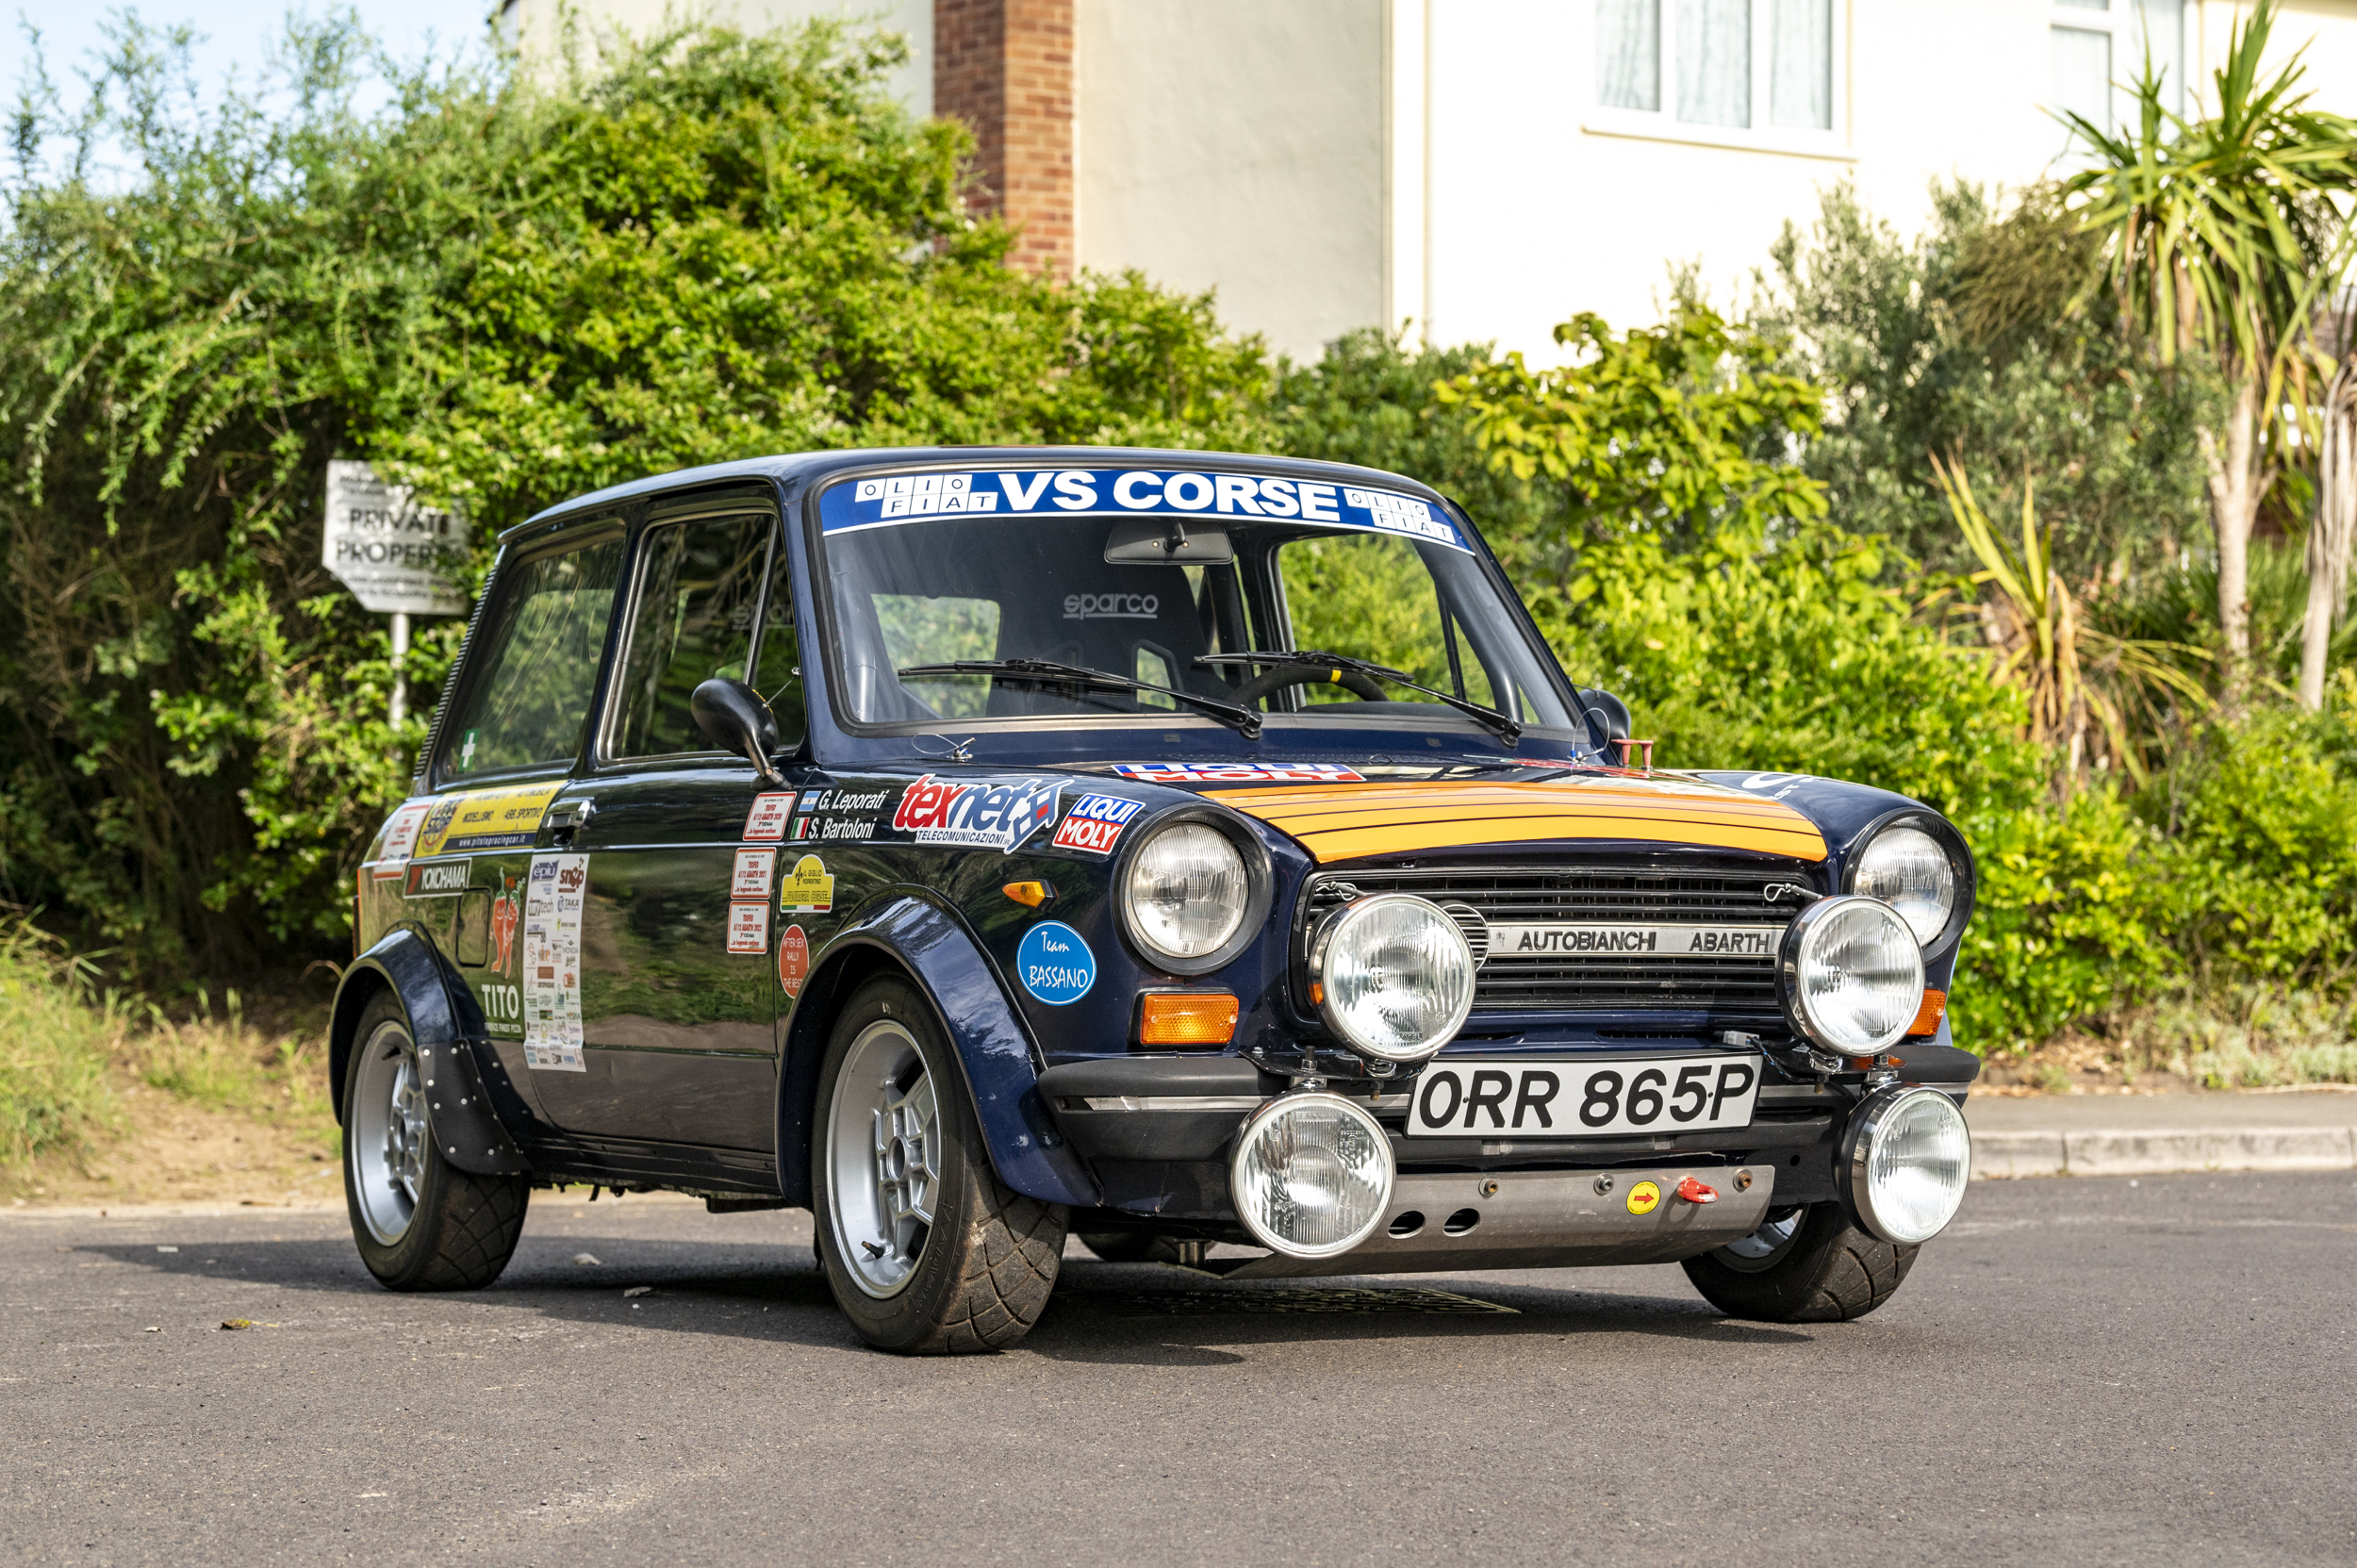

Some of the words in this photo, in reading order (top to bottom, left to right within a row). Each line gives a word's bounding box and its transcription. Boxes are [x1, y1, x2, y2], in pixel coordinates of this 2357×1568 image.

[865, 478, 963, 496] OLIO
[997, 471, 1098, 510] VS
[1113, 470, 1341, 521] CORSE
[891, 496, 991, 513] FIAT
[1351, 493, 1425, 516] OLIO
[1379, 513, 1447, 537] FIAT
[1063, 593, 1159, 619] sparco
[1134, 771, 1350, 781] MOLY
[818, 790, 830, 809] G.
[832, 789, 889, 813] Leporati
[894, 774, 1041, 832] texnet
[1072, 796, 1138, 821] LIQUI
[808, 817, 819, 838] S.
[821, 817, 878, 838] Bartoloni
[916, 830, 1004, 845] TELECOMUNICAZIONI
[1058, 819, 1121, 849] MOLY
[421, 865, 467, 890] YOKOHAMA
[783, 938, 796, 948] AFTER
[796, 938, 805, 948] SEX
[1041, 931, 1070, 952] Team
[1517, 932, 1656, 951] AUTOBIANCHI
[1689, 933, 1771, 952] ABARTH
[786, 951, 799, 961] RALLY
[790, 965, 796, 975] IS
[1029, 966, 1088, 989] BASSANO
[481, 984, 519, 1019] TITO
[1419, 1069, 1560, 1129] ORR
[1579, 1064, 1755, 1127] 865P
